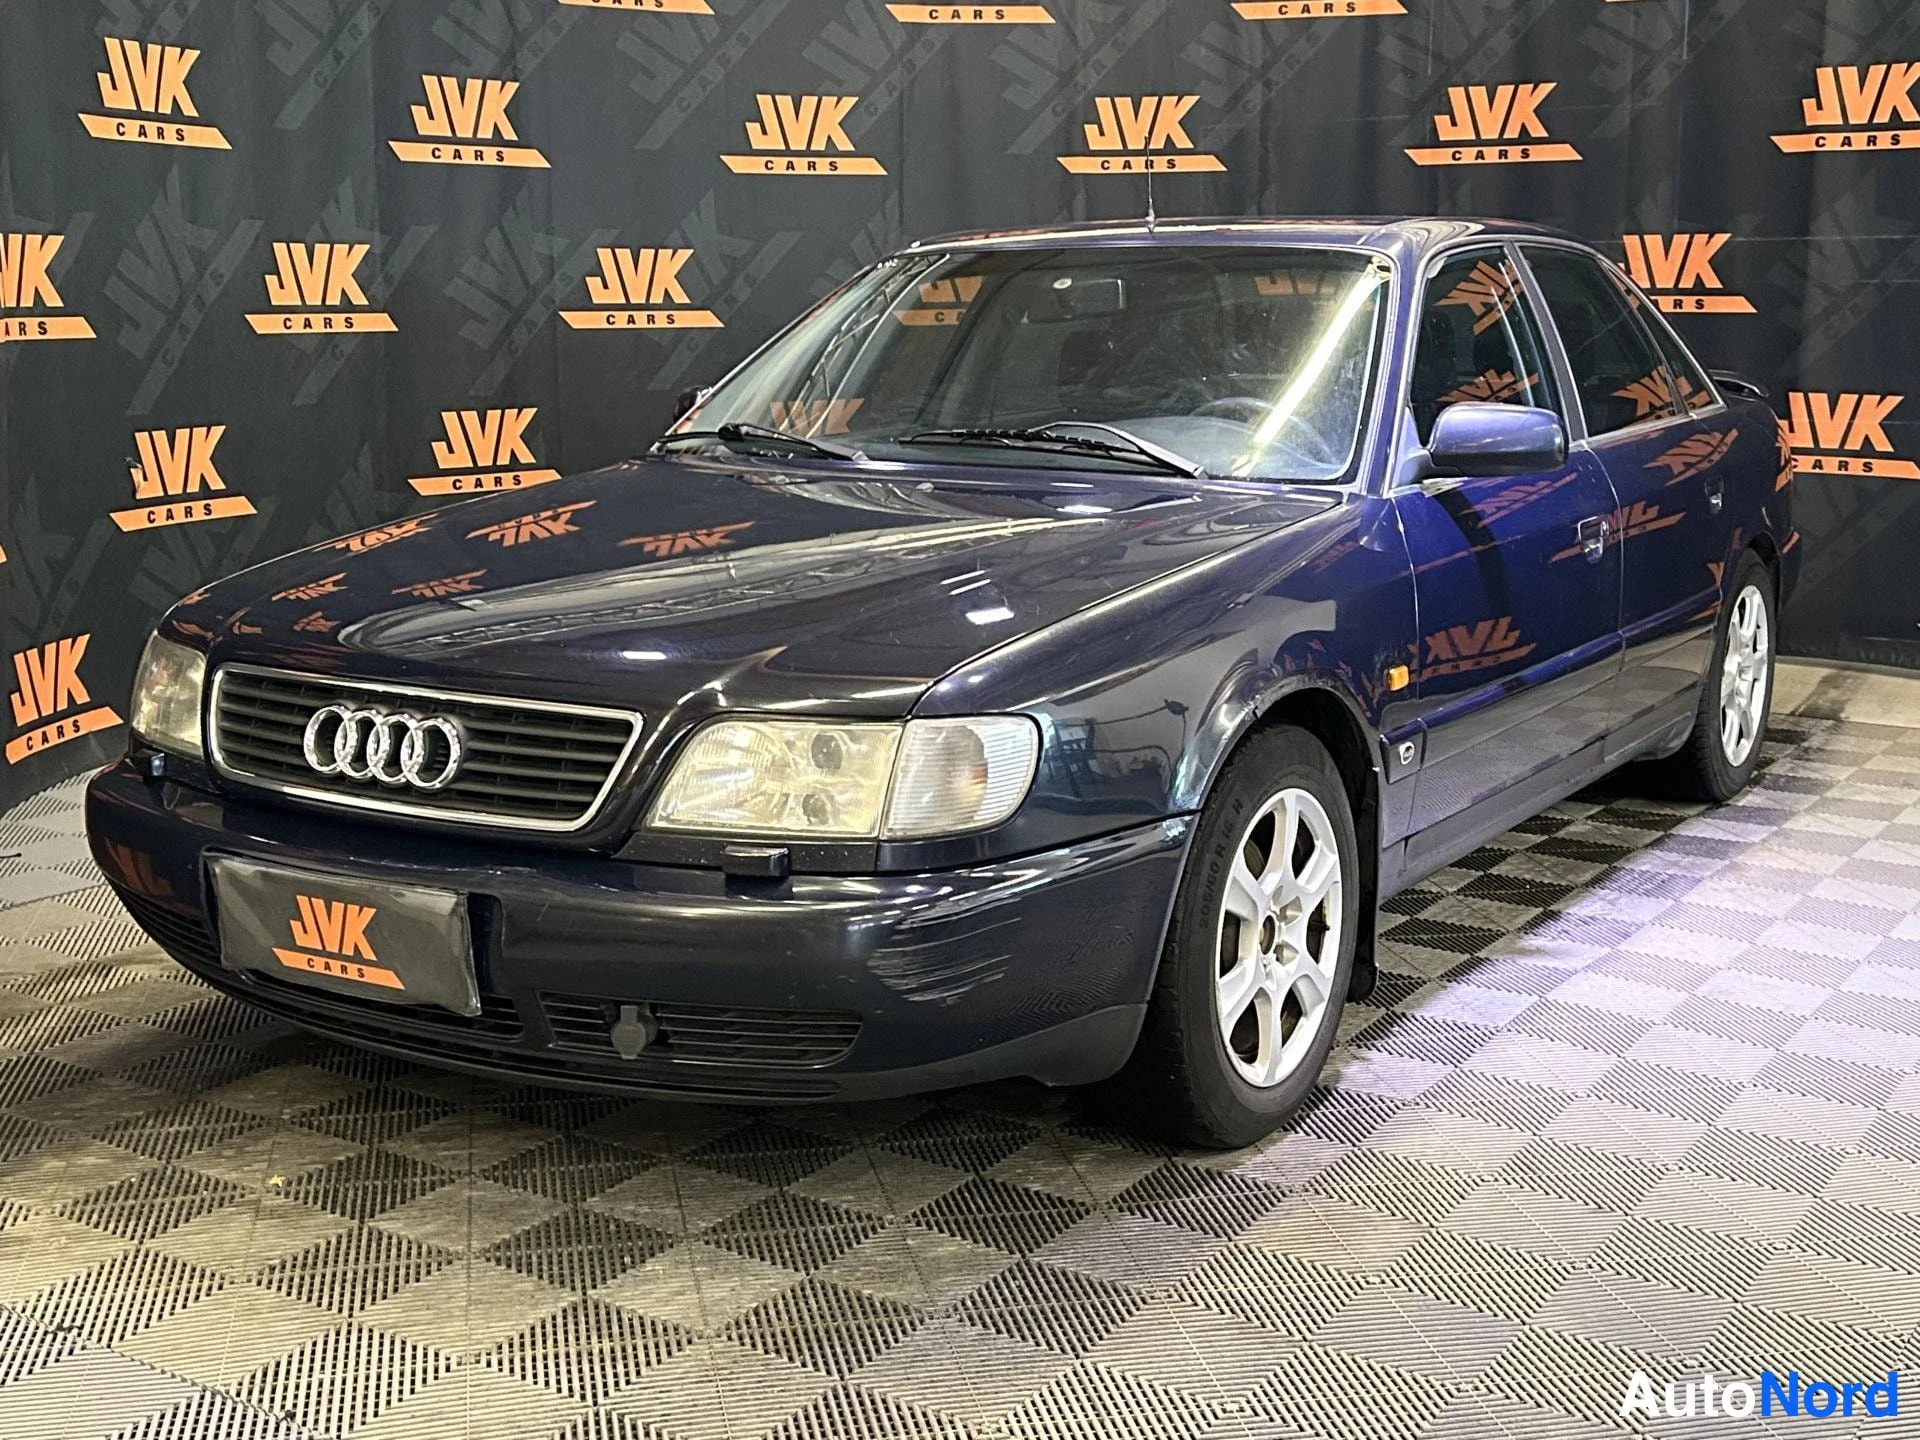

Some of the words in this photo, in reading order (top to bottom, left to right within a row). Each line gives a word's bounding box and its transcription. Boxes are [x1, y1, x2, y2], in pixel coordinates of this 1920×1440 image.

[929, 9, 1005, 20] CARS
[1278, 2, 1356, 15] CARS
[97, 36, 201, 118] JVK
[410, 74, 520, 141] JVK
[1802, 61, 1920, 127] JVK
[745, 94, 858, 151] JVK
[1084, 94, 1199, 150] JVK
[1434, 82, 1556, 142] JVK
[116, 122, 185, 142] CARS
[1814, 134, 1901, 149] CARS
[431, 147, 505, 164] CARS
[764, 159, 838, 172] CARS
[1101, 158, 1177, 171] CARS
[1451, 147, 1531, 162] CARS
[265, 242, 370, 306] JVK
[585, 247, 693, 305] JVK
[283, 316, 354, 331] CARS
[606, 314, 676, 326] CARS
[432, 408, 537, 469] JVK
[1778, 391, 1905, 453] JVK
[131, 425, 226, 499] JVK
[452, 474, 522, 491] CARS
[147, 503, 213, 524] CARS
[11, 633, 92, 728] JVK
[26, 719, 80, 752] CARS
[289, 895, 379, 962] JVK
[307, 958, 364, 979] CARS
